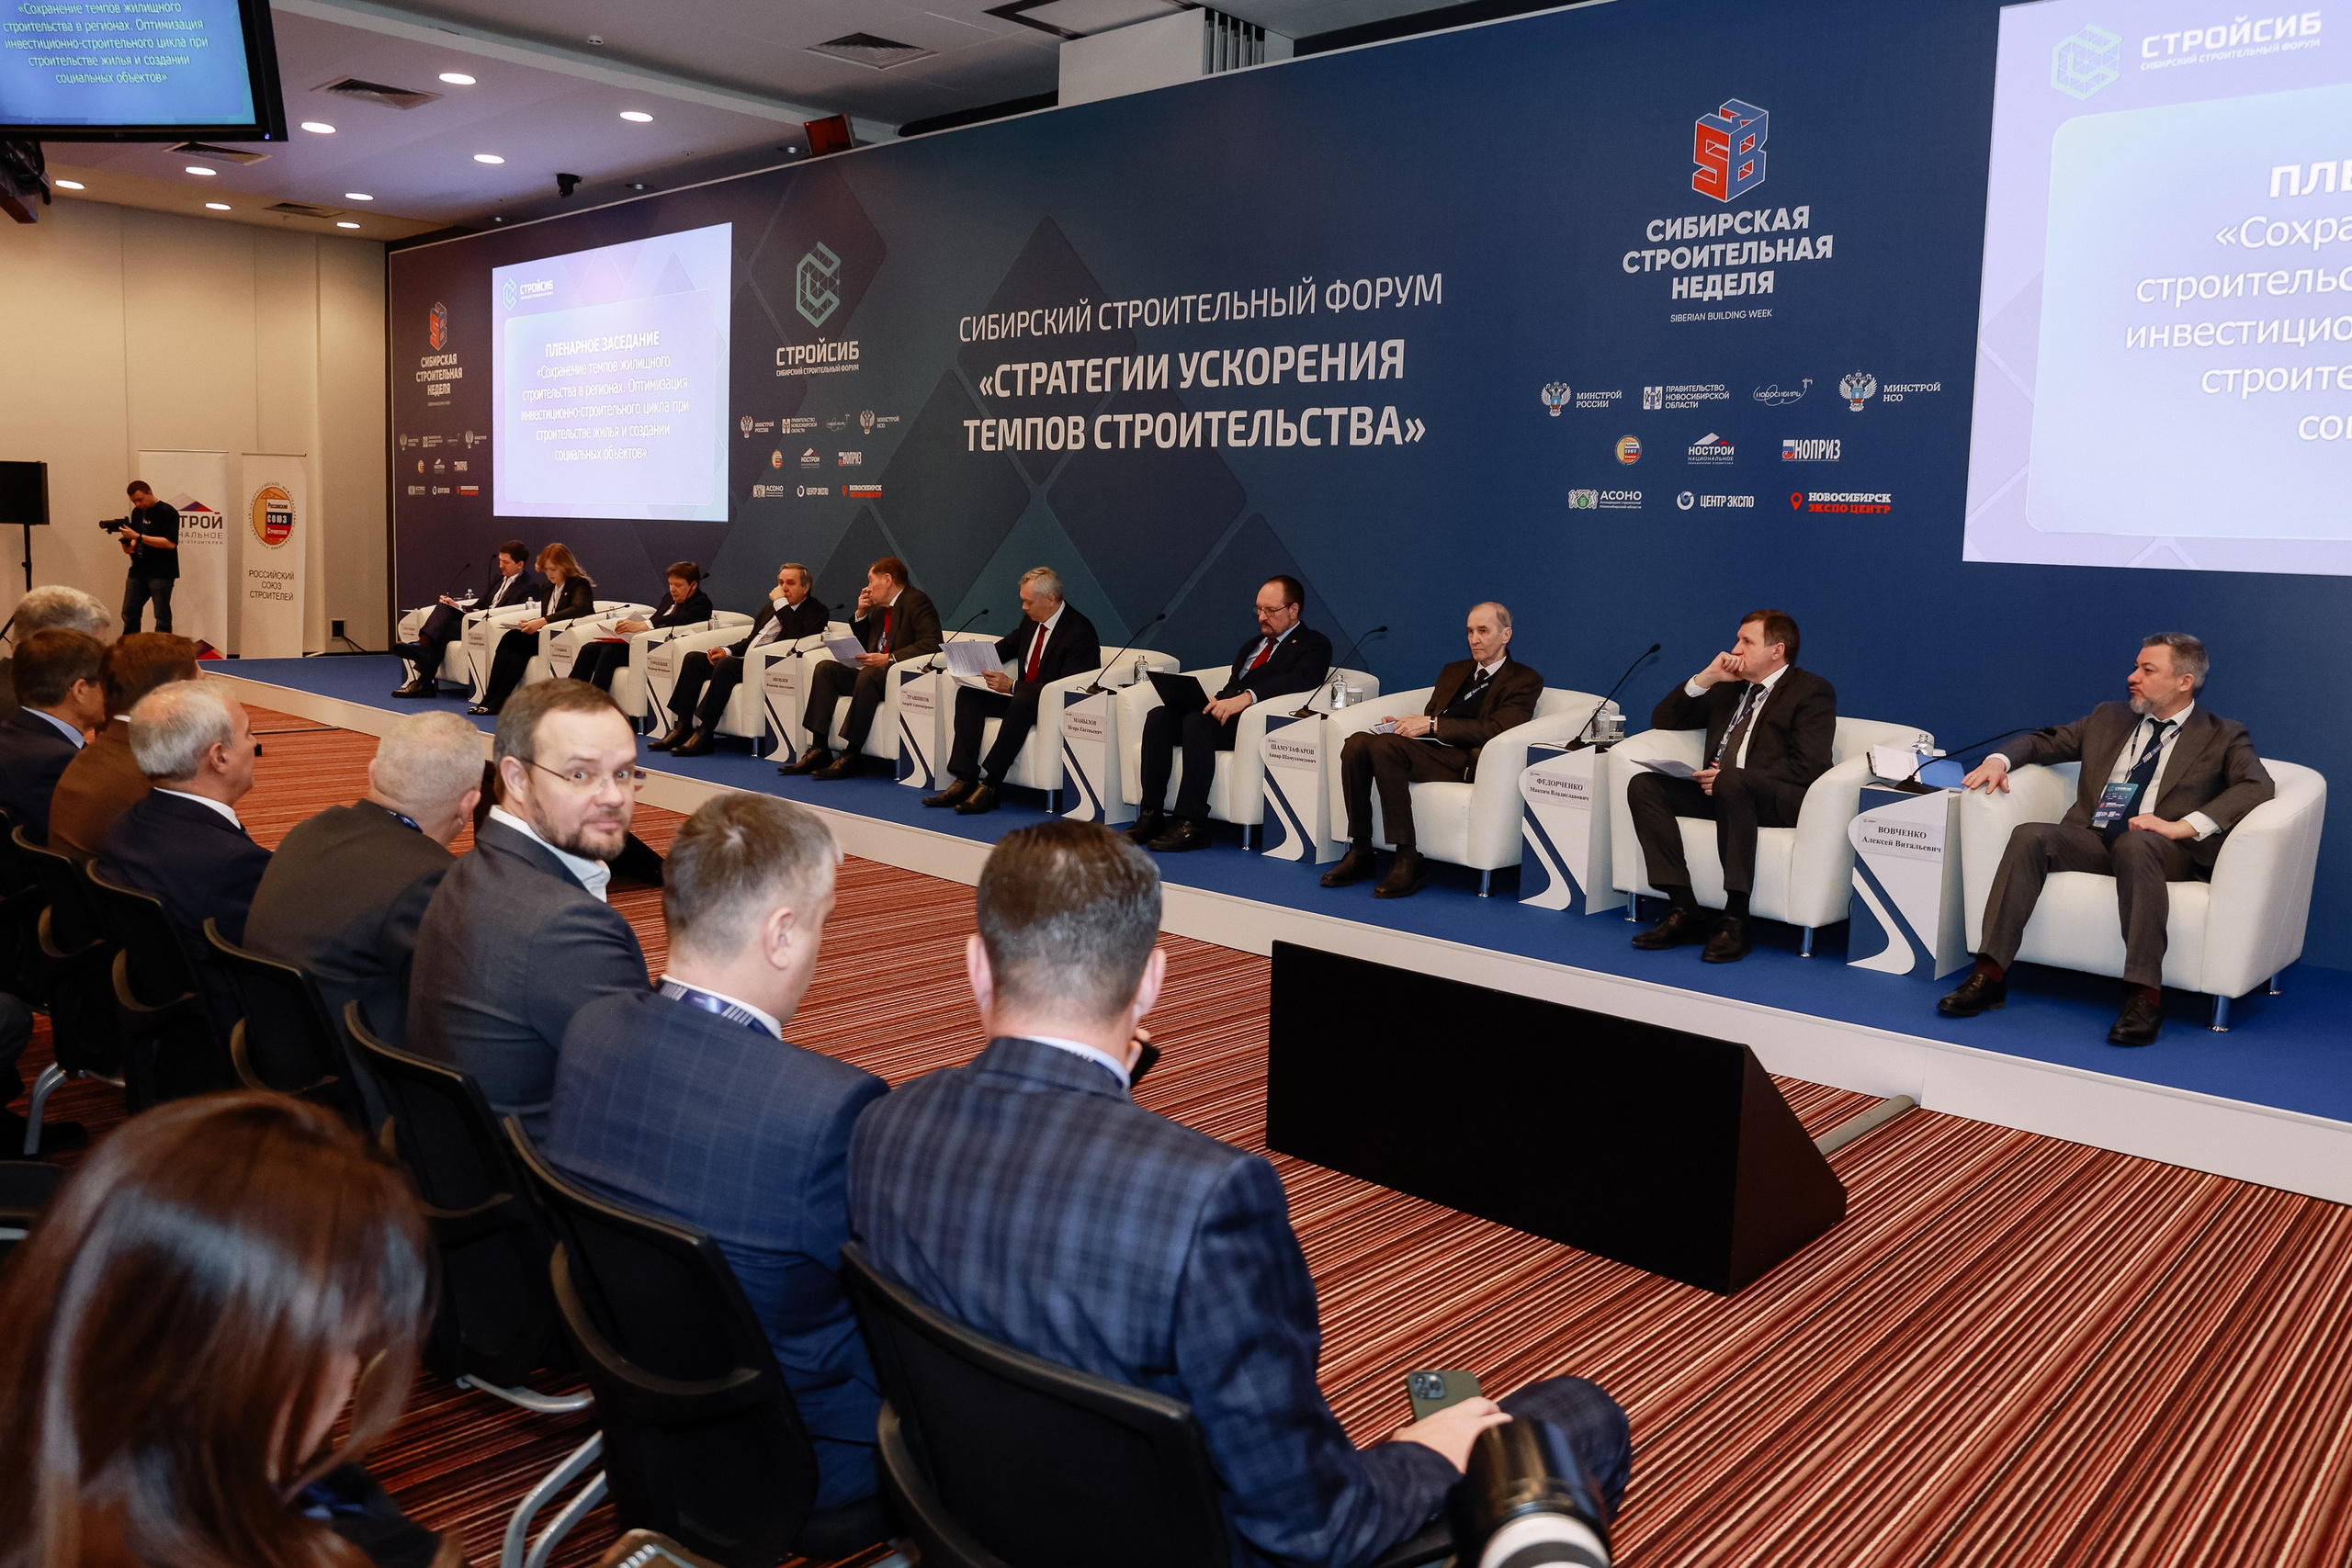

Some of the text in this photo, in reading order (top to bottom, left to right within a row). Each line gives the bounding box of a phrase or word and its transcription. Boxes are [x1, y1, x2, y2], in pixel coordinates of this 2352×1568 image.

[18, 2, 182, 16] «Сохранение темпов жилищного
[3, 18, 204, 35] строительства в регионах. Оптимизация
[2142, 11, 2322, 60] СТРОЙСИБ
[5, 37, 209, 51] инвестиционно-строительного цикла при
[28, 55, 190, 68] строительстве жилья и создании
[2140, 38, 2321, 71] СИБИРСКИЙ СТРОИТЕЛЬНЫЙ ФОРУМ
[56, 72, 167, 85] социальных объектов»
[1646, 205, 1810, 243] СИБИРСКАЯ
[1623, 234, 1834, 274] СТРОИТЕЛЬНАЯ
[520, 278, 553, 295] СТРОЙСИБ
[1671, 270, 1775, 301] НЕДЕЛЯ
[958, 273, 1442, 343] СИБИРСКИЙ СТРОИТЕЛЬНЫЙ ФОРУМ
[1670, 309, 1773, 322] SIBERIAN BUILDING WEEK
[2125, 315, 2352, 349] инвестицио
[546, 331, 660, 357] ПЛЕНАРНОЕ ЗАСЕДАНИЕ
[776, 337, 860, 367] СТРОЙСИБ
[421, 354, 458, 367] СИБИРСКАЯ
[537, 355, 671, 380] «Сохранение темпов жилищного
[416, 367, 463, 382] СТРОИТЕЛЬНАЯ
[979, 338, 1406, 398] «СТРАТЕГИИ УСКОРЕНИЯ
[427, 383, 451, 397] НЕДЕЛЯ
[523, 377, 688, 403] строительства в регионах. Оптимизация
[1666, 384, 1725, 392] ПРАВИТЕЛЬСТВО
[1883, 381, 1941, 392] МИНСТРОЙ
[1577, 390, 1623, 400] МИНСТРОЙ
[1666, 391, 1730, 400] НОВОСИБИРСКОЙ
[1883, 394, 1904, 402] НСО
[521, 400, 690, 421] инвестиционно-строительного цикла при
[537, 423, 670, 443] строительстве жилья и создании
[963, 405, 1426, 452] ТЕМПОВ СТРОИТЕЛЬСТВА»
[555, 445, 648, 462] социальных объектов»
[1794, 439, 1840, 459] НОПРИЗ
[1600, 491, 1642, 501] АСОНО
[1700, 495, 1754, 508] ЦЕНТР ЭКСПО
[1808, 492, 1892, 502] НОВОСИБИРСК
[1807, 504, 1891, 514] ЭКСПО ЦЕНТР
[249, 570, 294, 581] РОССИЙСКИЙ
[262, 581, 282, 590] СОЮЗ
[250, 591, 294, 601] СТРОИТЕЛЕЙ
[1271, 744, 1315, 755] ШАМУЗАФАРОВ
[1537, 778, 1583, 791] ФЕДОРЧЕНКО
[1878, 826, 1927, 839] ВОВЧЕНКО
[1862, 836, 1941, 852] Алексей Витальевич
